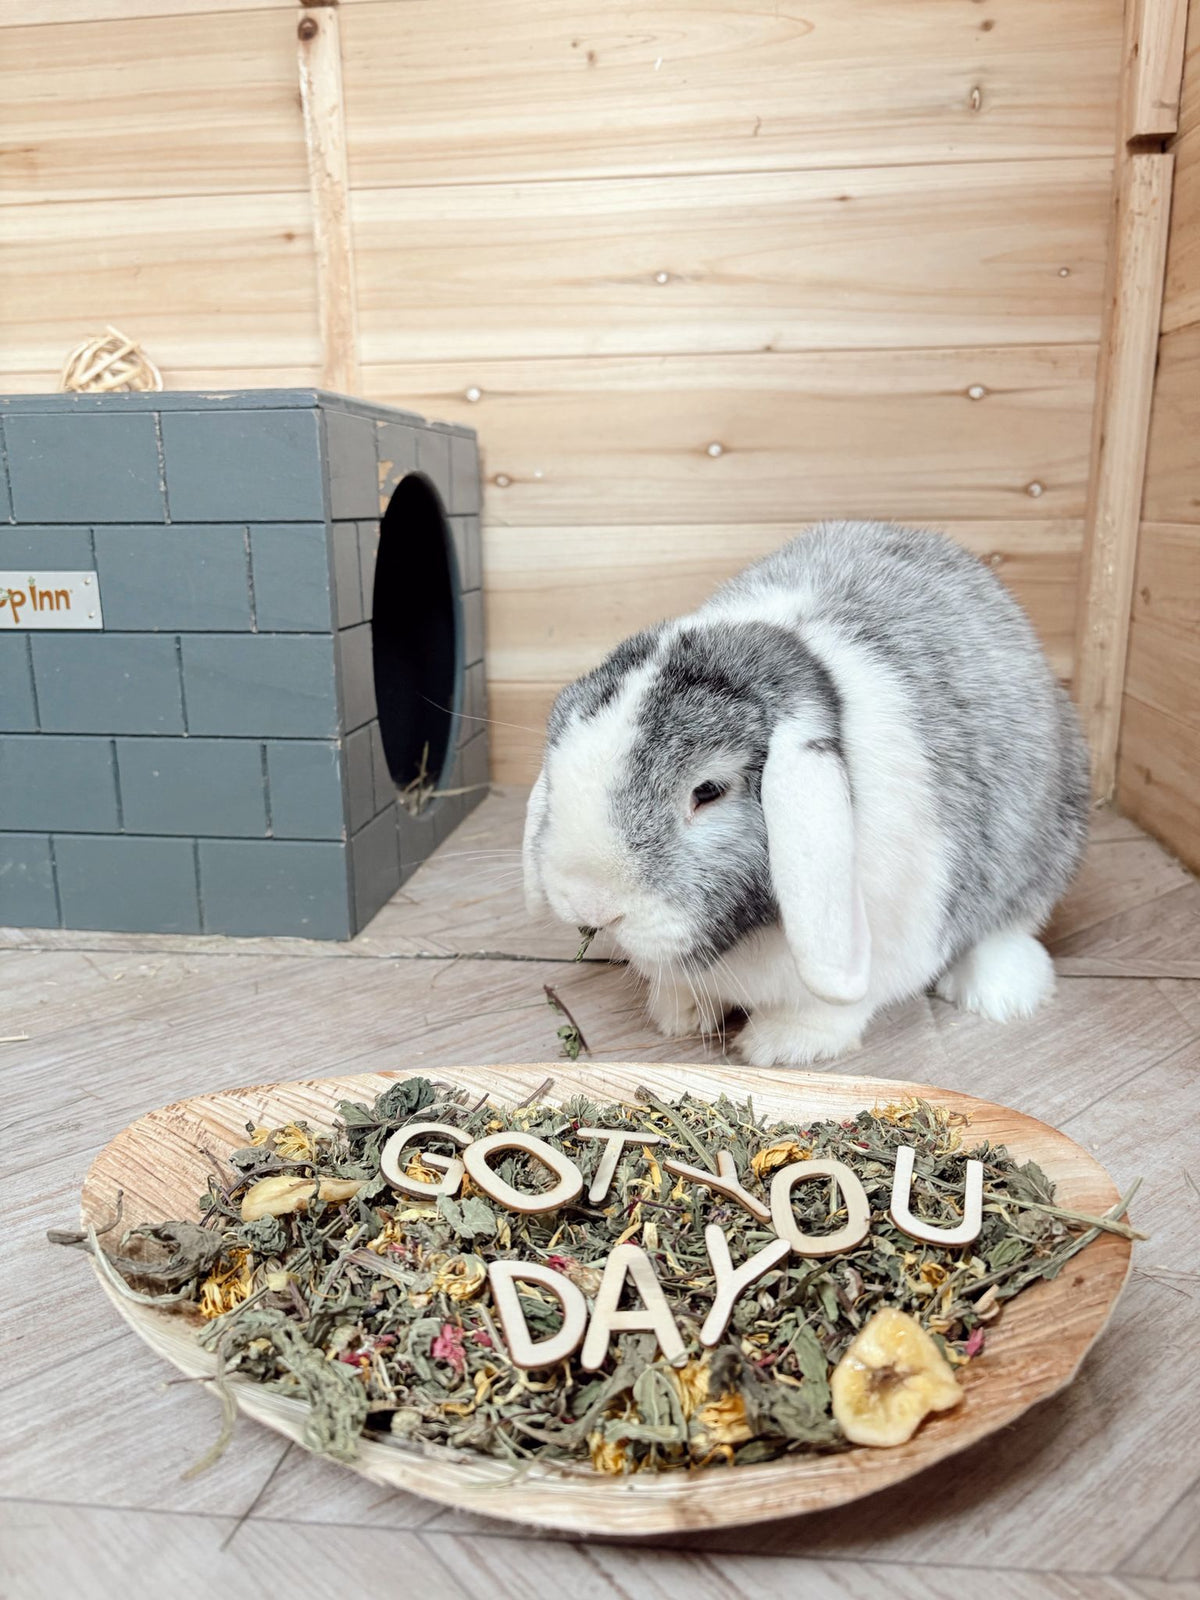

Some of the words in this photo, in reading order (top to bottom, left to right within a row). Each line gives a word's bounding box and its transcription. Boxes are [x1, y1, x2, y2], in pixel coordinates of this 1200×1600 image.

[380, 1122, 661, 1214] GOT
[664, 1145, 985, 1257] YOU
[488, 1224, 792, 1370] DAY
